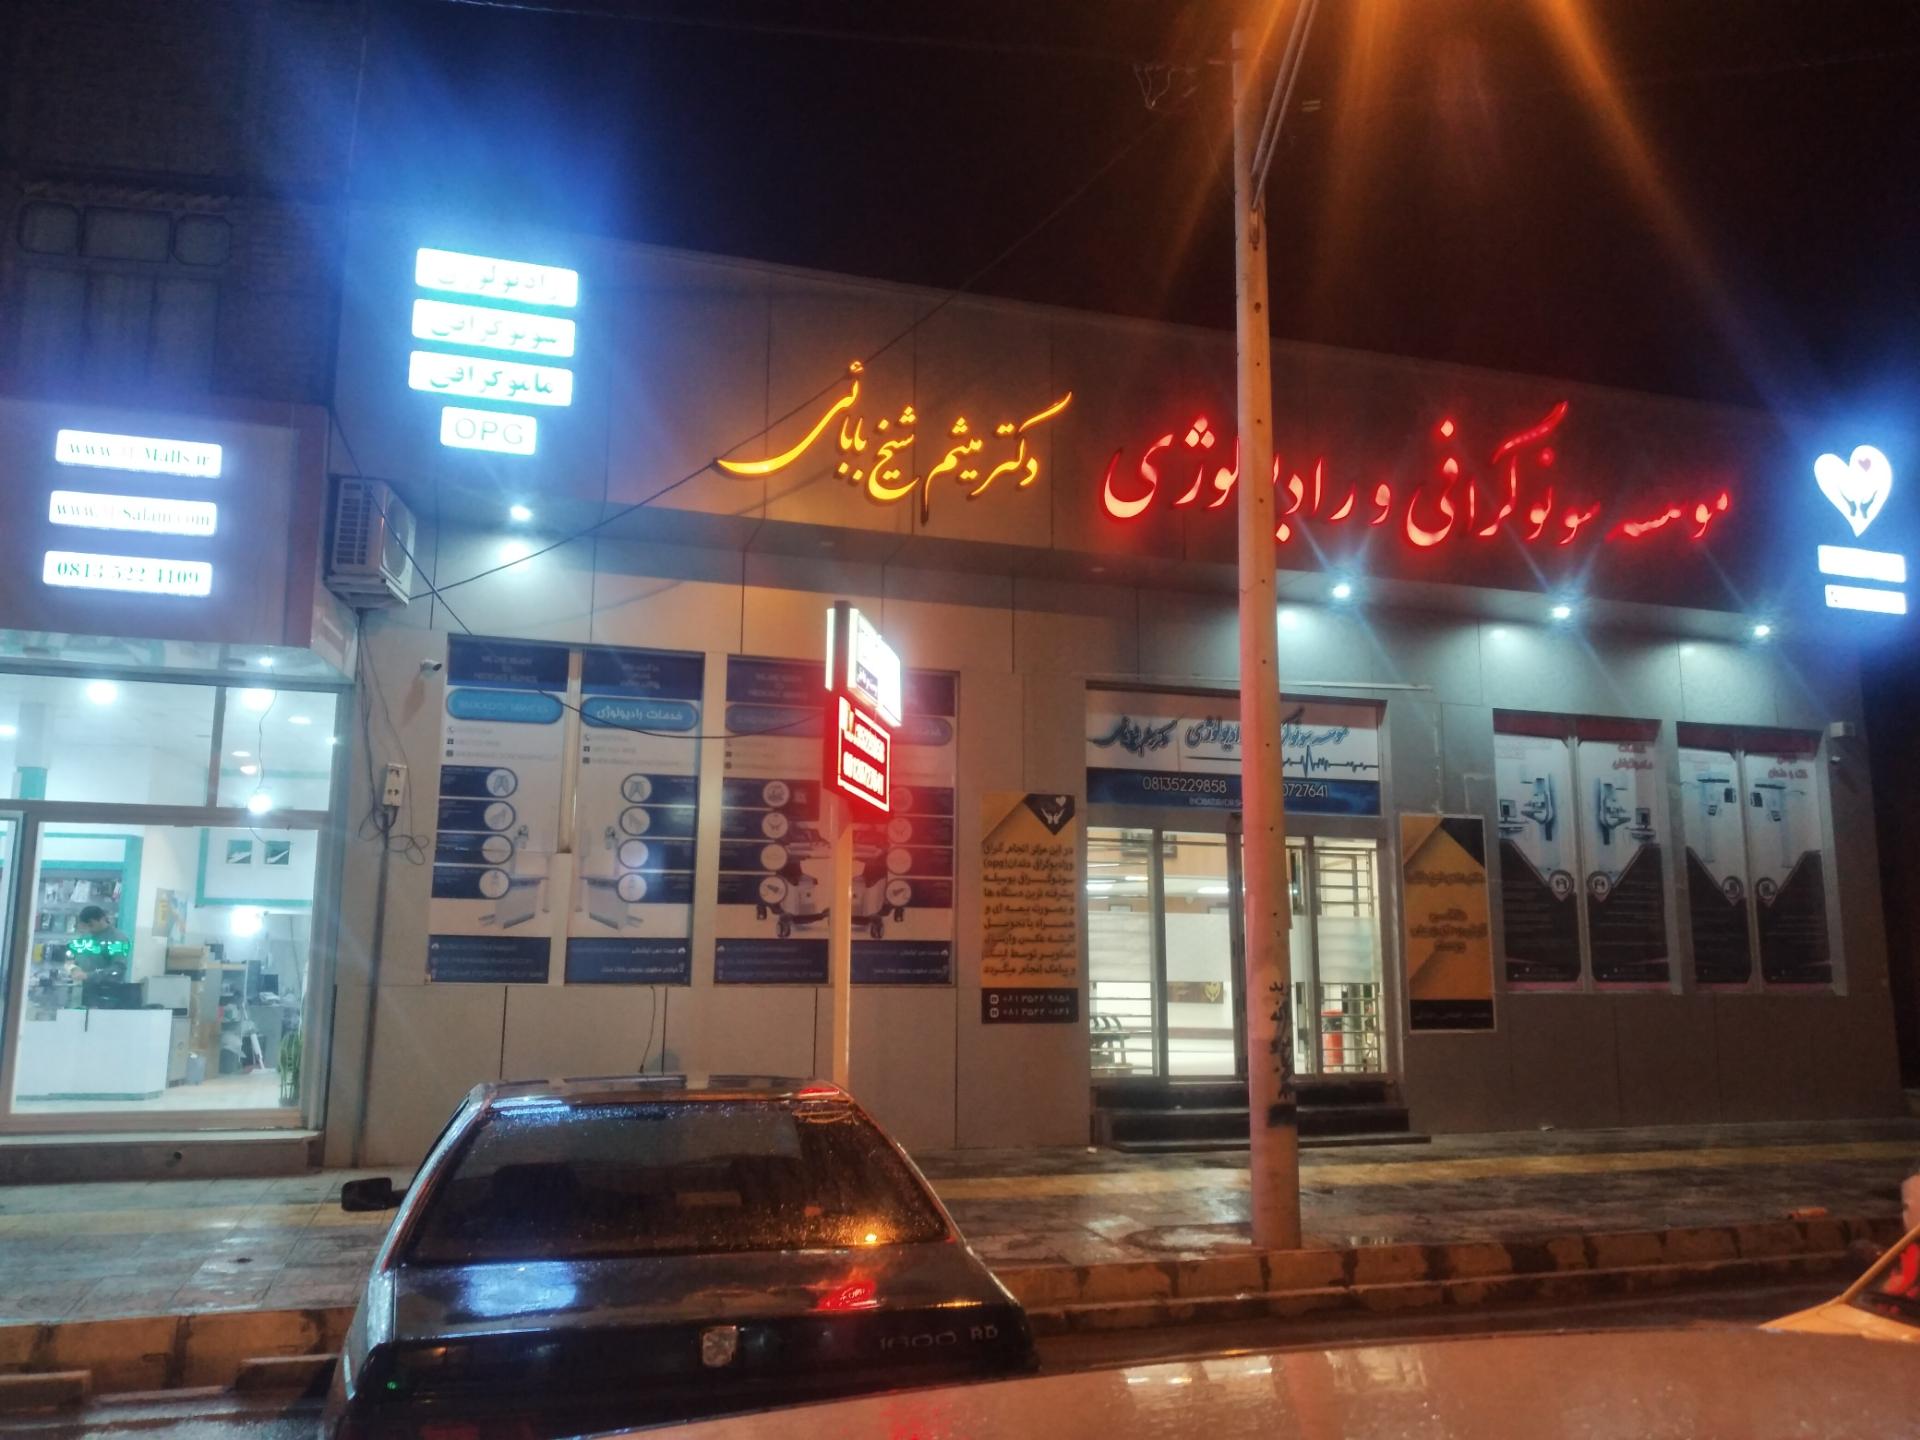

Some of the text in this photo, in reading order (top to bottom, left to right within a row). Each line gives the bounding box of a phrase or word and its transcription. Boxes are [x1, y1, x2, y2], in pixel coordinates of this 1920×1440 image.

[436, 264, 558, 301] رادیولوی
[428, 365, 554, 397] ماموگرافی
[454, 417, 524, 445] OPG
[971, 391, 1073, 496] دکتر
[867, 405, 920, 501] شیخ
[922, 416, 983, 526] میثم
[1405, 400, 1601, 546] سونوگرافی
[1103, 416, 1355, 543] رادیلوژی
[1371, 482, 1392, 526] و
[596, 704, 643, 721] رادیولوژی
[1142, 776, 1228, 794] 08135229858
[969, 1323, 999, 1342] RD
